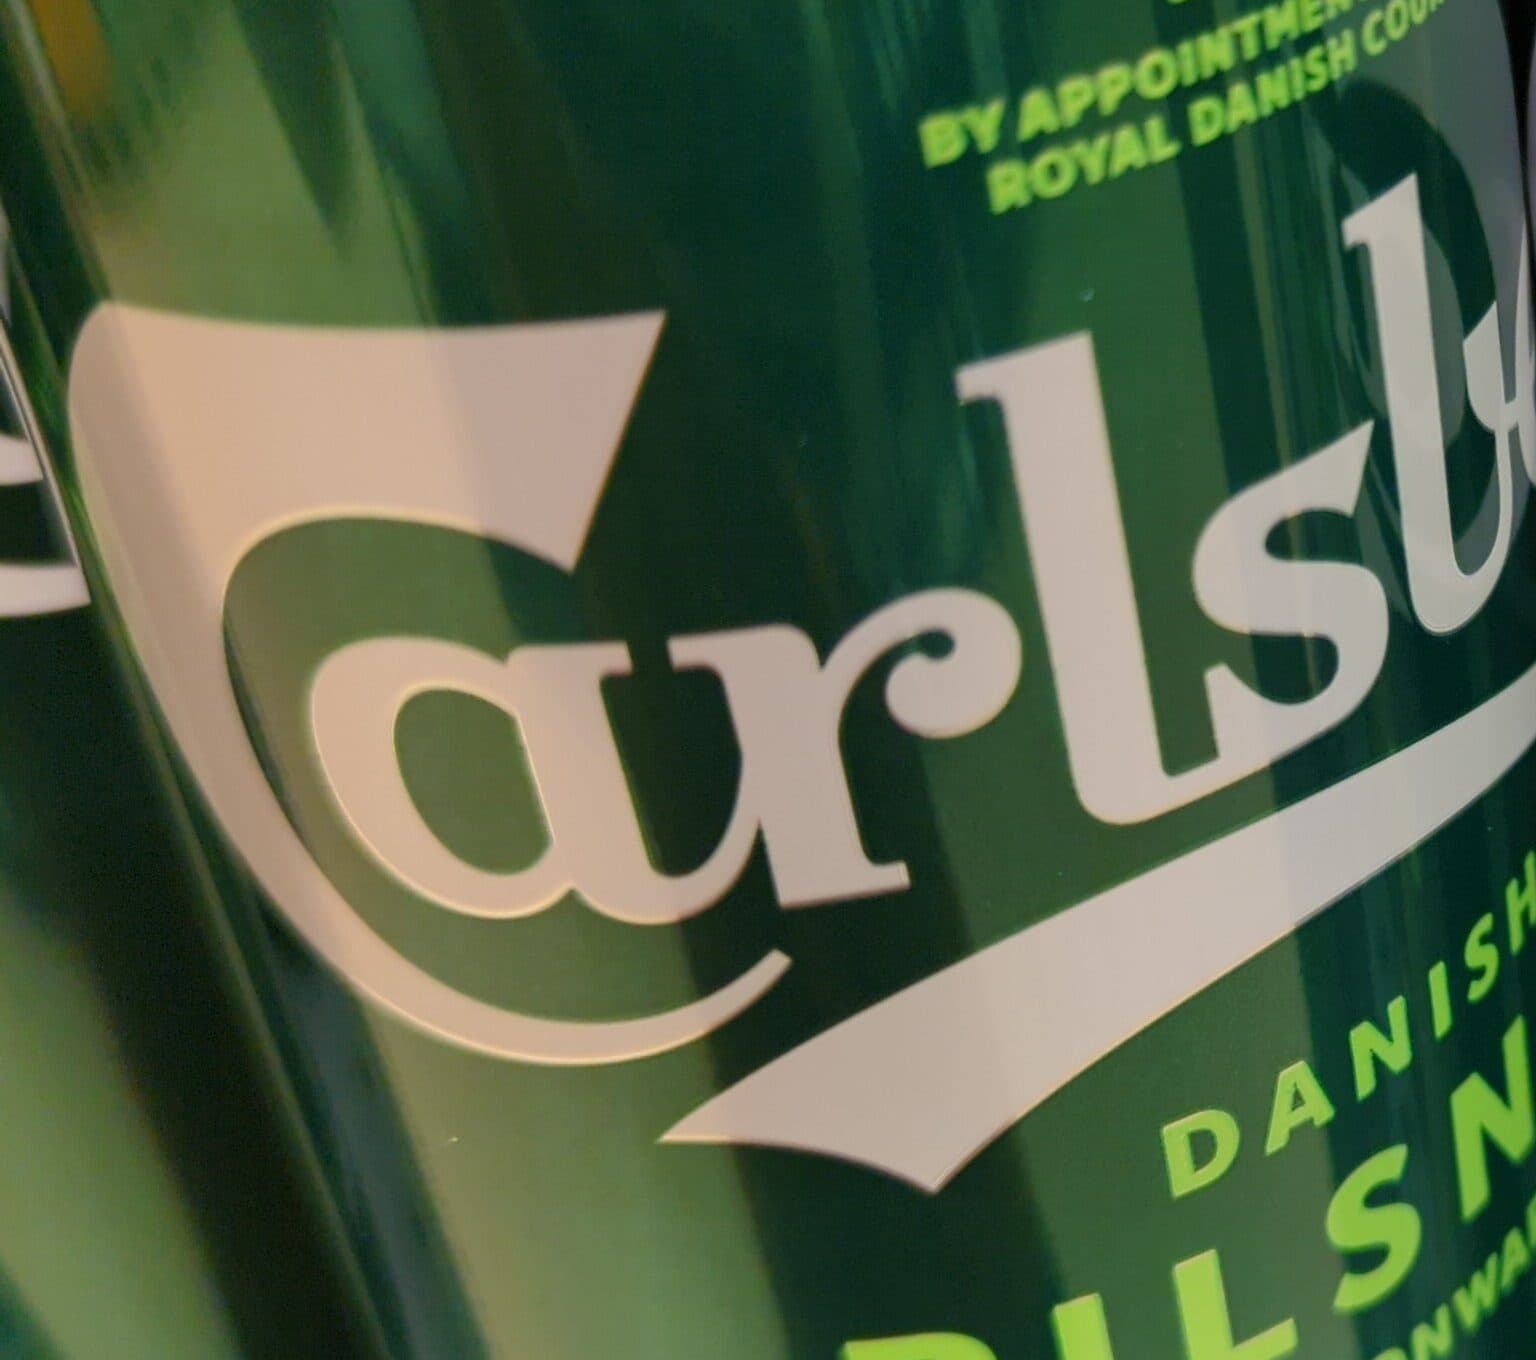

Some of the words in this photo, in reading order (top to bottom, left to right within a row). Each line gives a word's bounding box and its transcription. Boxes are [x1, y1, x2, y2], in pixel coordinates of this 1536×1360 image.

[919, 97, 1005, 167] BY
[985, 114, 1181, 214] ROYAL
[1187, 30, 1357, 147] DANISH
